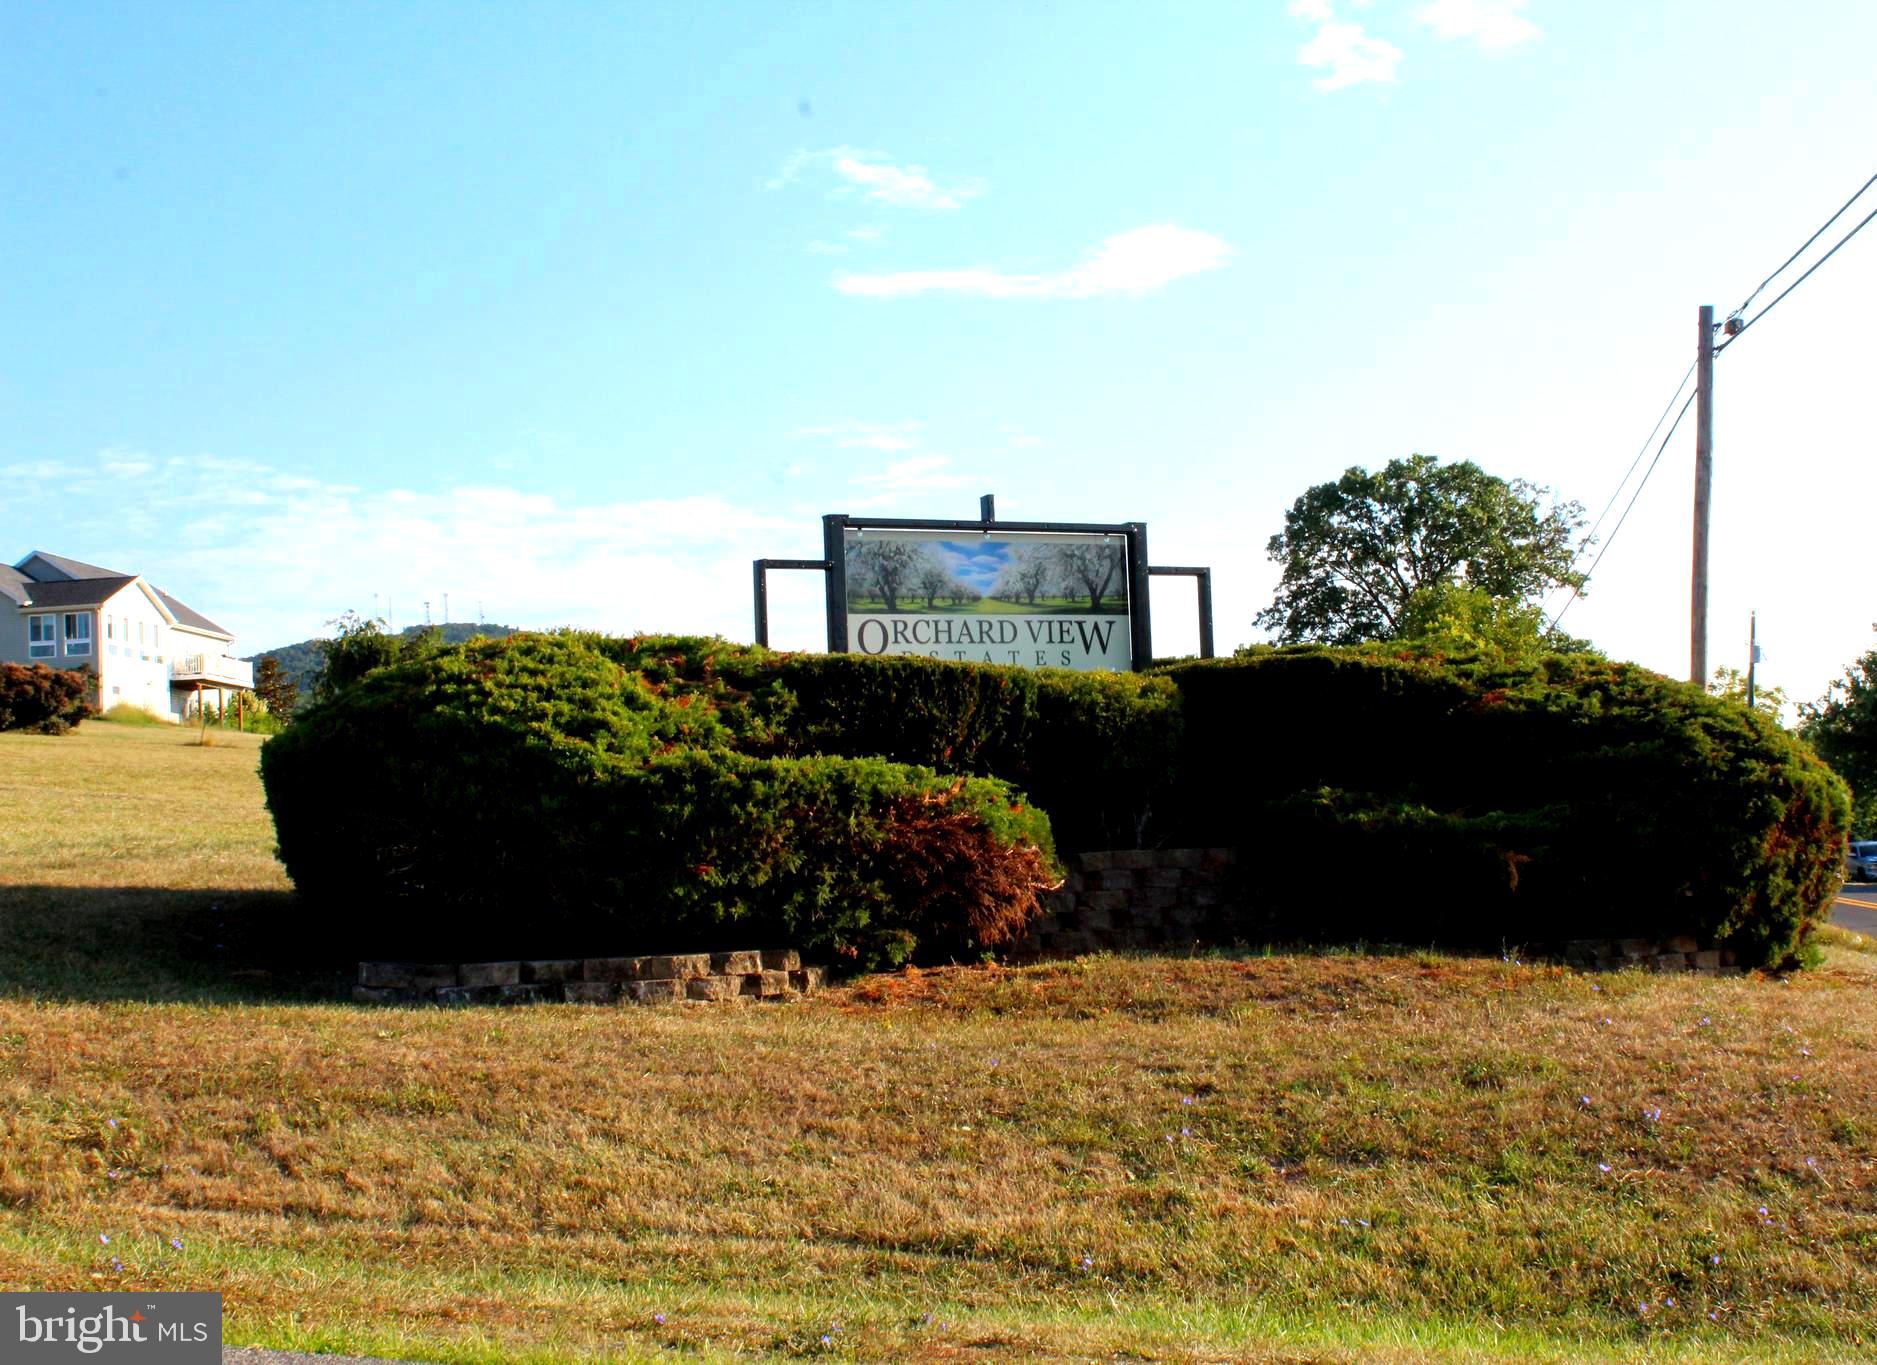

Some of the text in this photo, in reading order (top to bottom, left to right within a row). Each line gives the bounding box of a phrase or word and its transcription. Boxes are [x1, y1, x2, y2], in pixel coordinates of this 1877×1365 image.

[857, 618, 1116, 655] ORCHARD VIEW
[901, 650, 1071, 666] TATES
